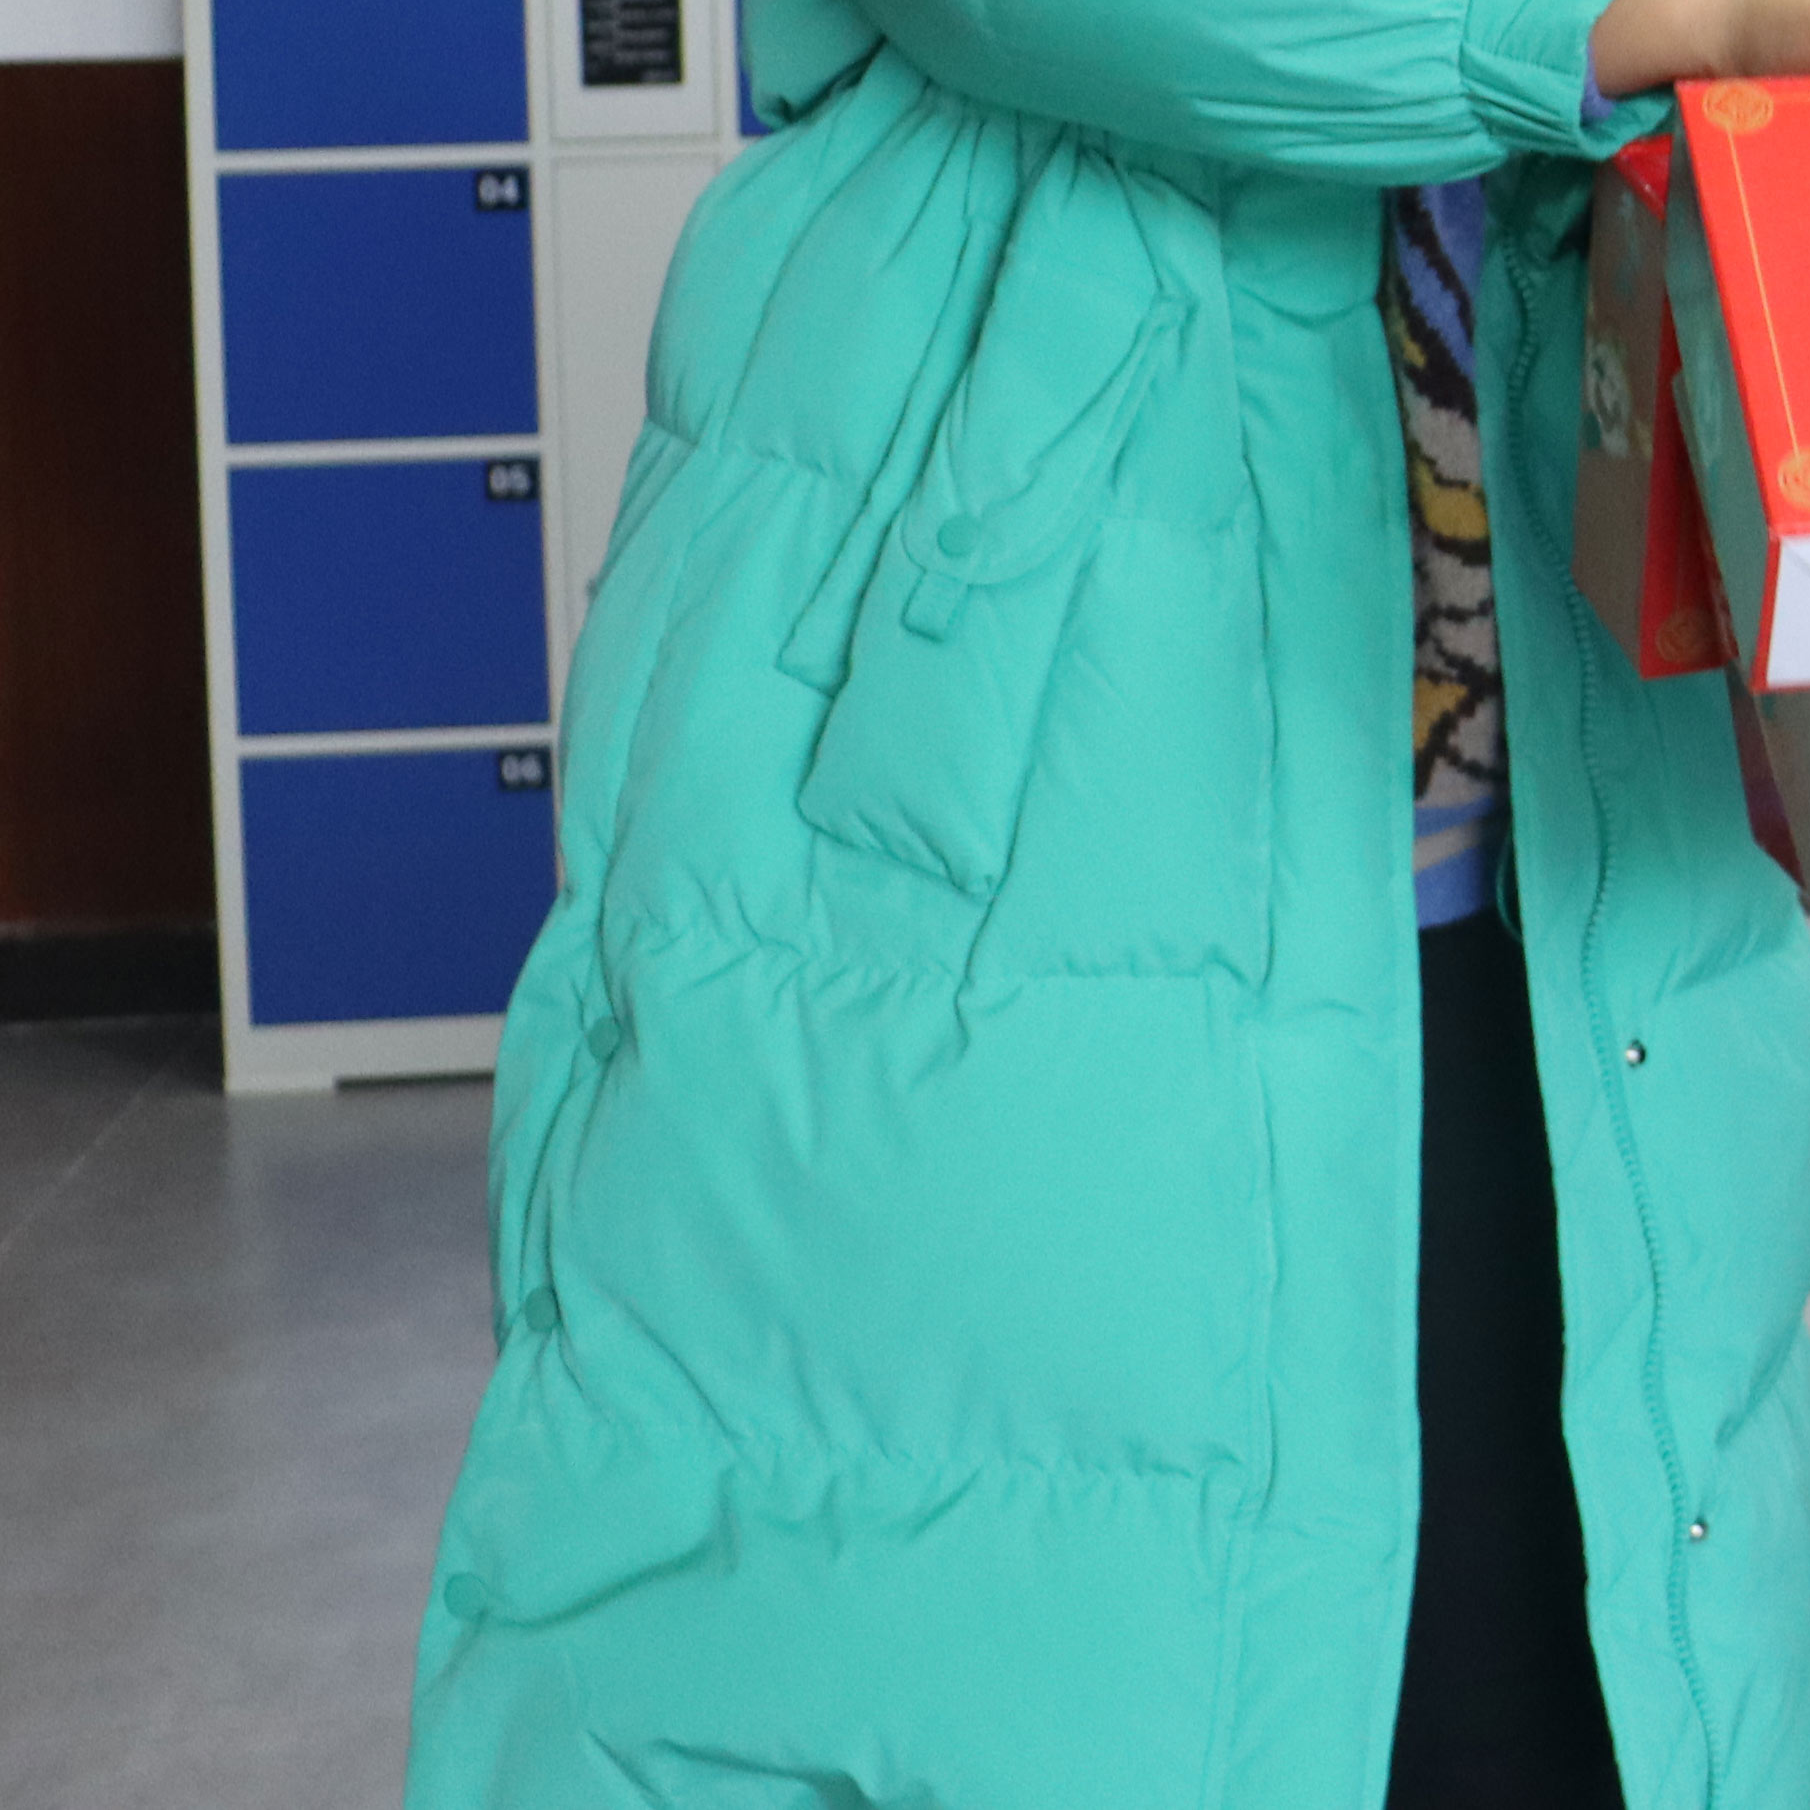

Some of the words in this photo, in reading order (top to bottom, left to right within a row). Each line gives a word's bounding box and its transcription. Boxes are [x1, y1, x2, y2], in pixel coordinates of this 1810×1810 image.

[479, 174, 520, 205] 04
[489, 465, 532, 496] 05
[500, 754, 543, 785] 06
